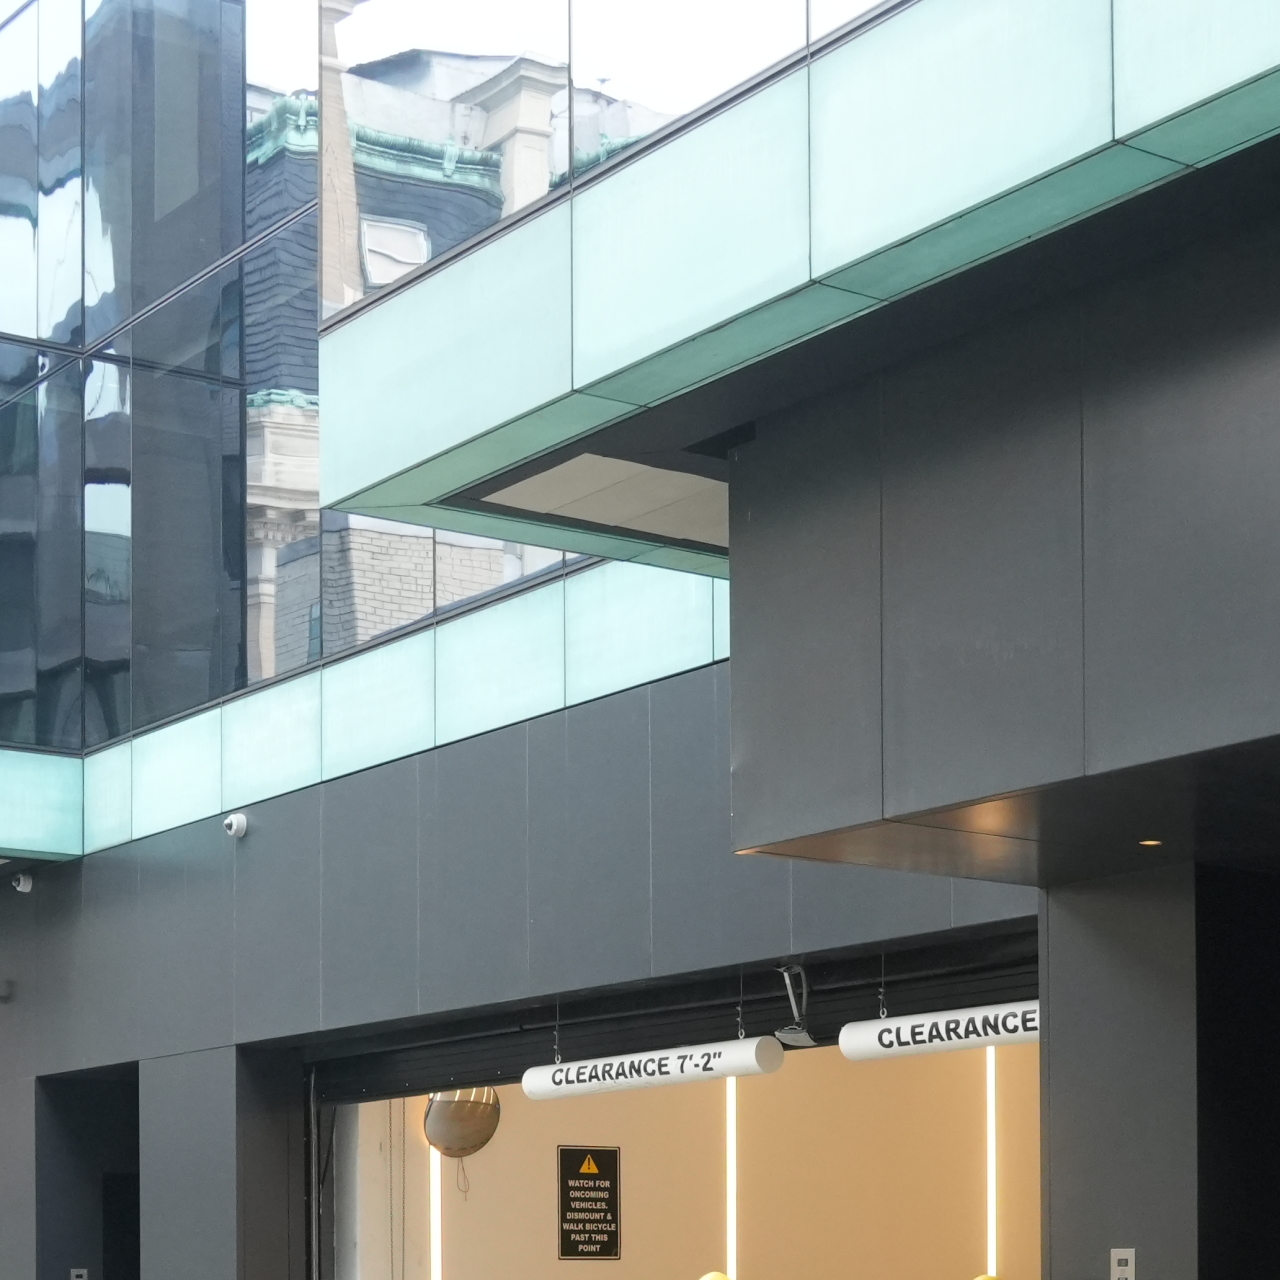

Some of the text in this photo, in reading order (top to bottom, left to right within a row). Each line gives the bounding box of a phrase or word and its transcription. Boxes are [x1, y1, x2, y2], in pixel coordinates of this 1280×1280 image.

[877, 1009, 1039, 1048] CLEARANCE
[551, 1051, 722, 1086] CLEARANCE 7'-2"
[568, 1179, 610, 1188] WATCH FOR
[569, 1190, 609, 1199] ONCOMING
[570, 1201, 608, 1209] VEHICLES.
[566, 1212, 612, 1220] DISMOUNT &
[585, 1223, 616, 1231] BICYCLE
[570, 1233, 590, 1241] PAST
[578, 1244, 601, 1252] POINT
